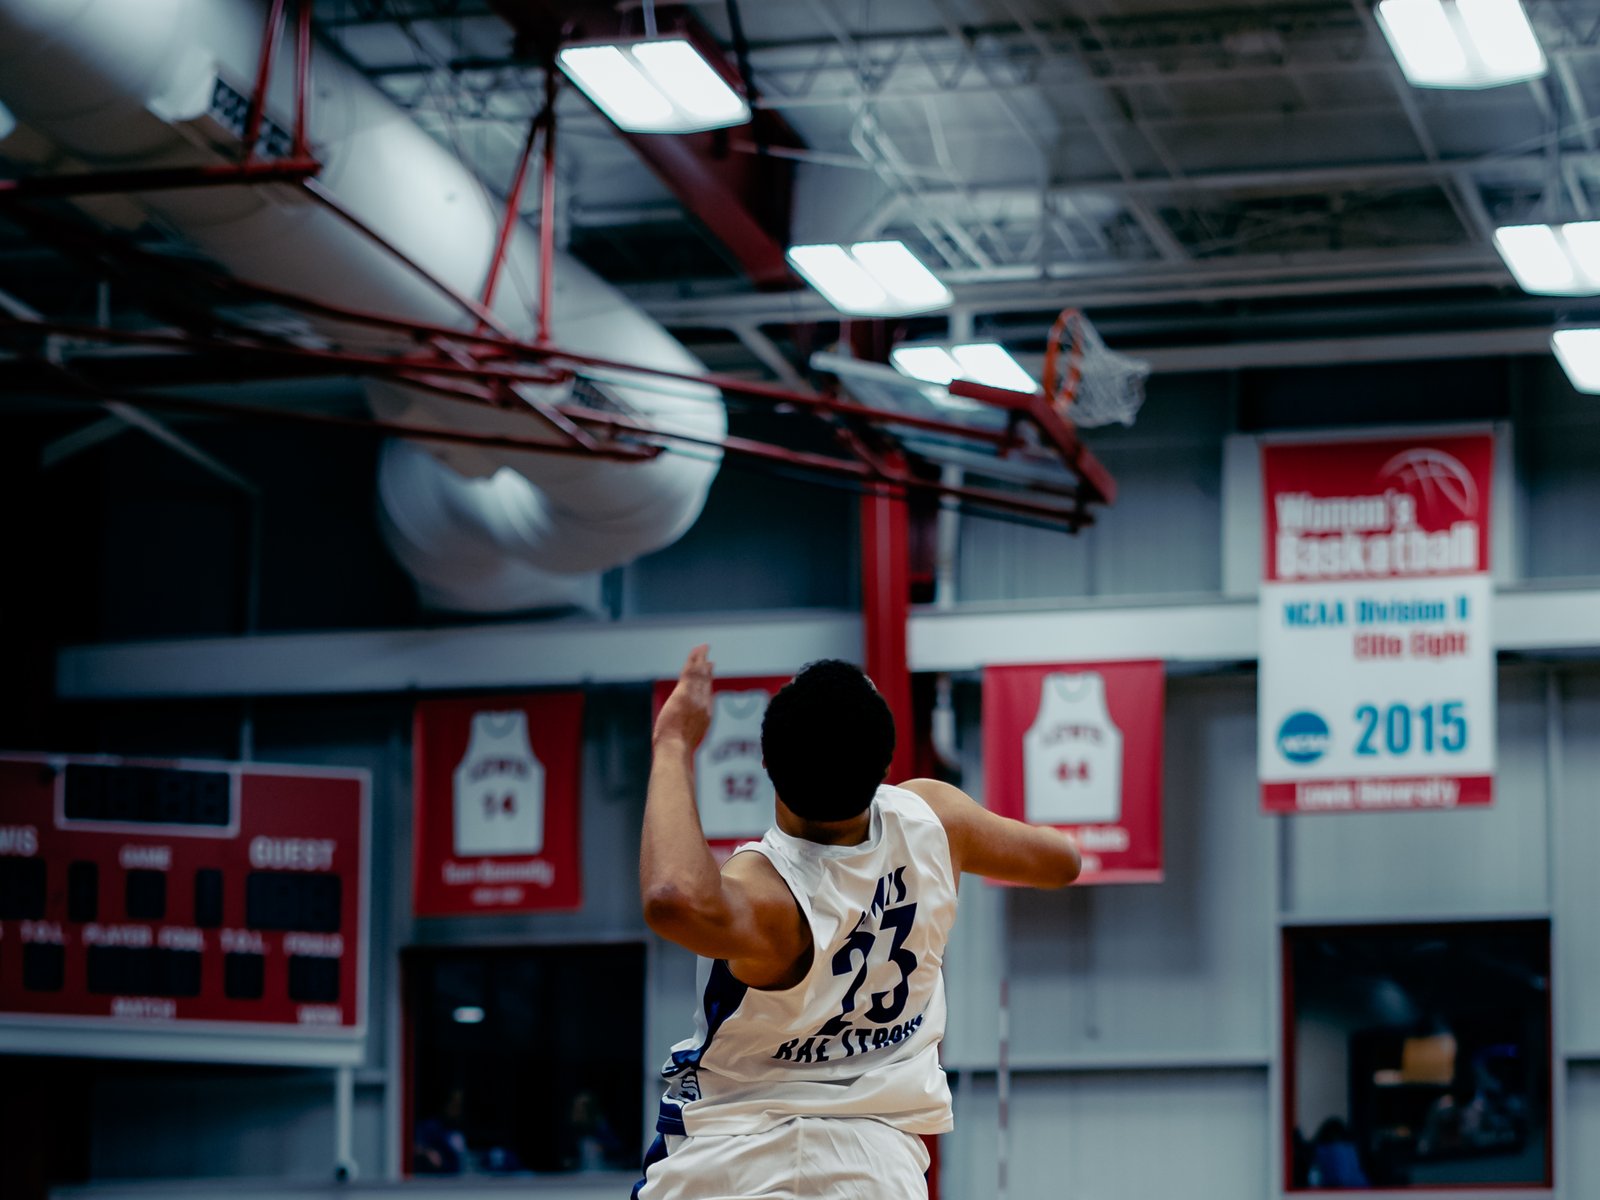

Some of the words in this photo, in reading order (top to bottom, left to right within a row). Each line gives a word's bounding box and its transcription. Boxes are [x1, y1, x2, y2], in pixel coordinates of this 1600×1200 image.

[1274, 490, 1415, 530] Women's
[1275, 523, 1478, 577] Basketball
[1283, 601, 1345, 626] NCAA
[1356, 600, 1445, 624] Division
[1354, 702, 1468, 756] 2015
[249, 837, 336, 870] GUEST
[815, 902, 918, 1037] 23
